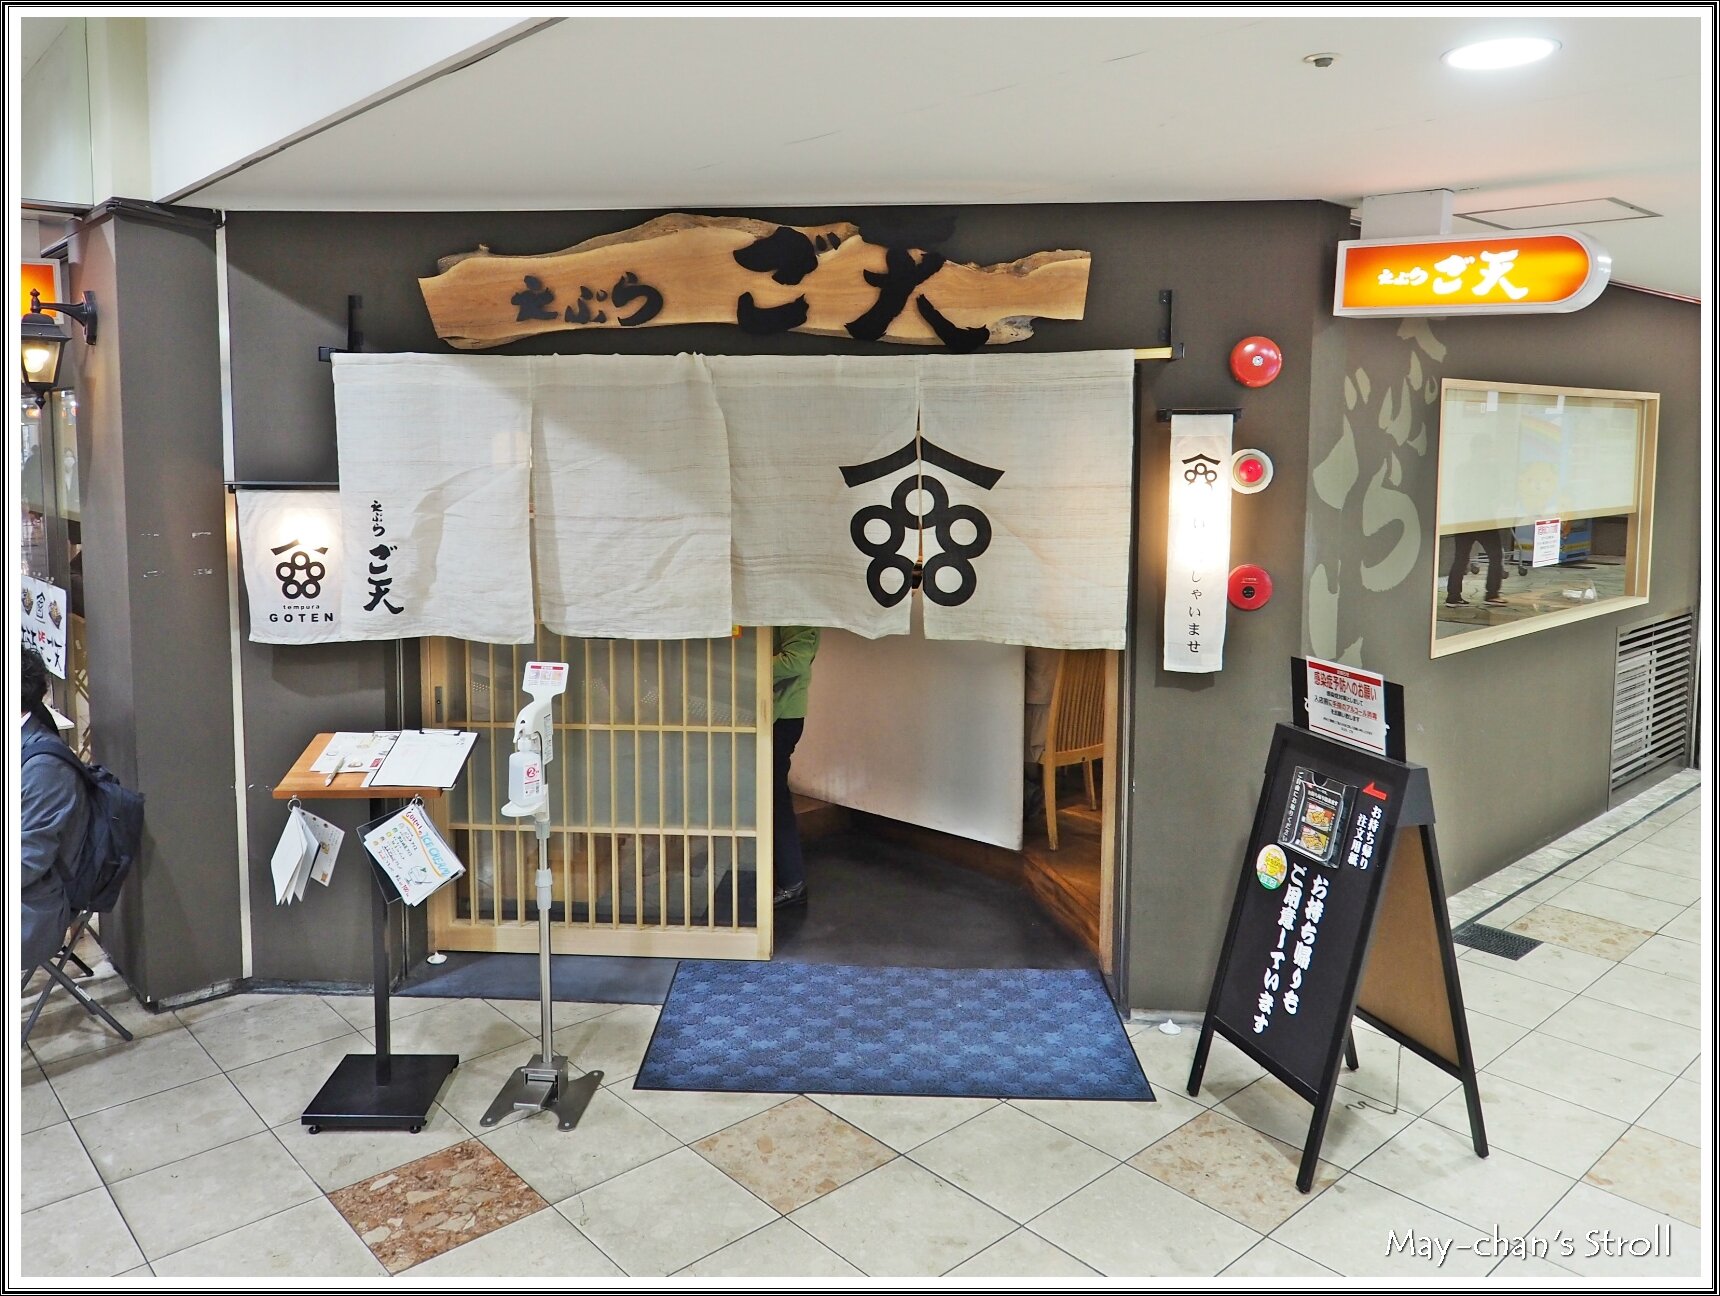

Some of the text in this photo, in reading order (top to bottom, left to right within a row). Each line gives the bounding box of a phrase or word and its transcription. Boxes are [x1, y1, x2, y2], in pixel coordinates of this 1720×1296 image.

[1432, 249, 1529, 300] ご天
[363, 543, 405, 615] ご天
[269, 612, 334, 623] GOTEN
[1347, 813, 1368, 868] 注文用紙
[1359, 805, 1383, 870] お持ち帰り
[1282, 873, 1330, 1015] お持ち帰りも
